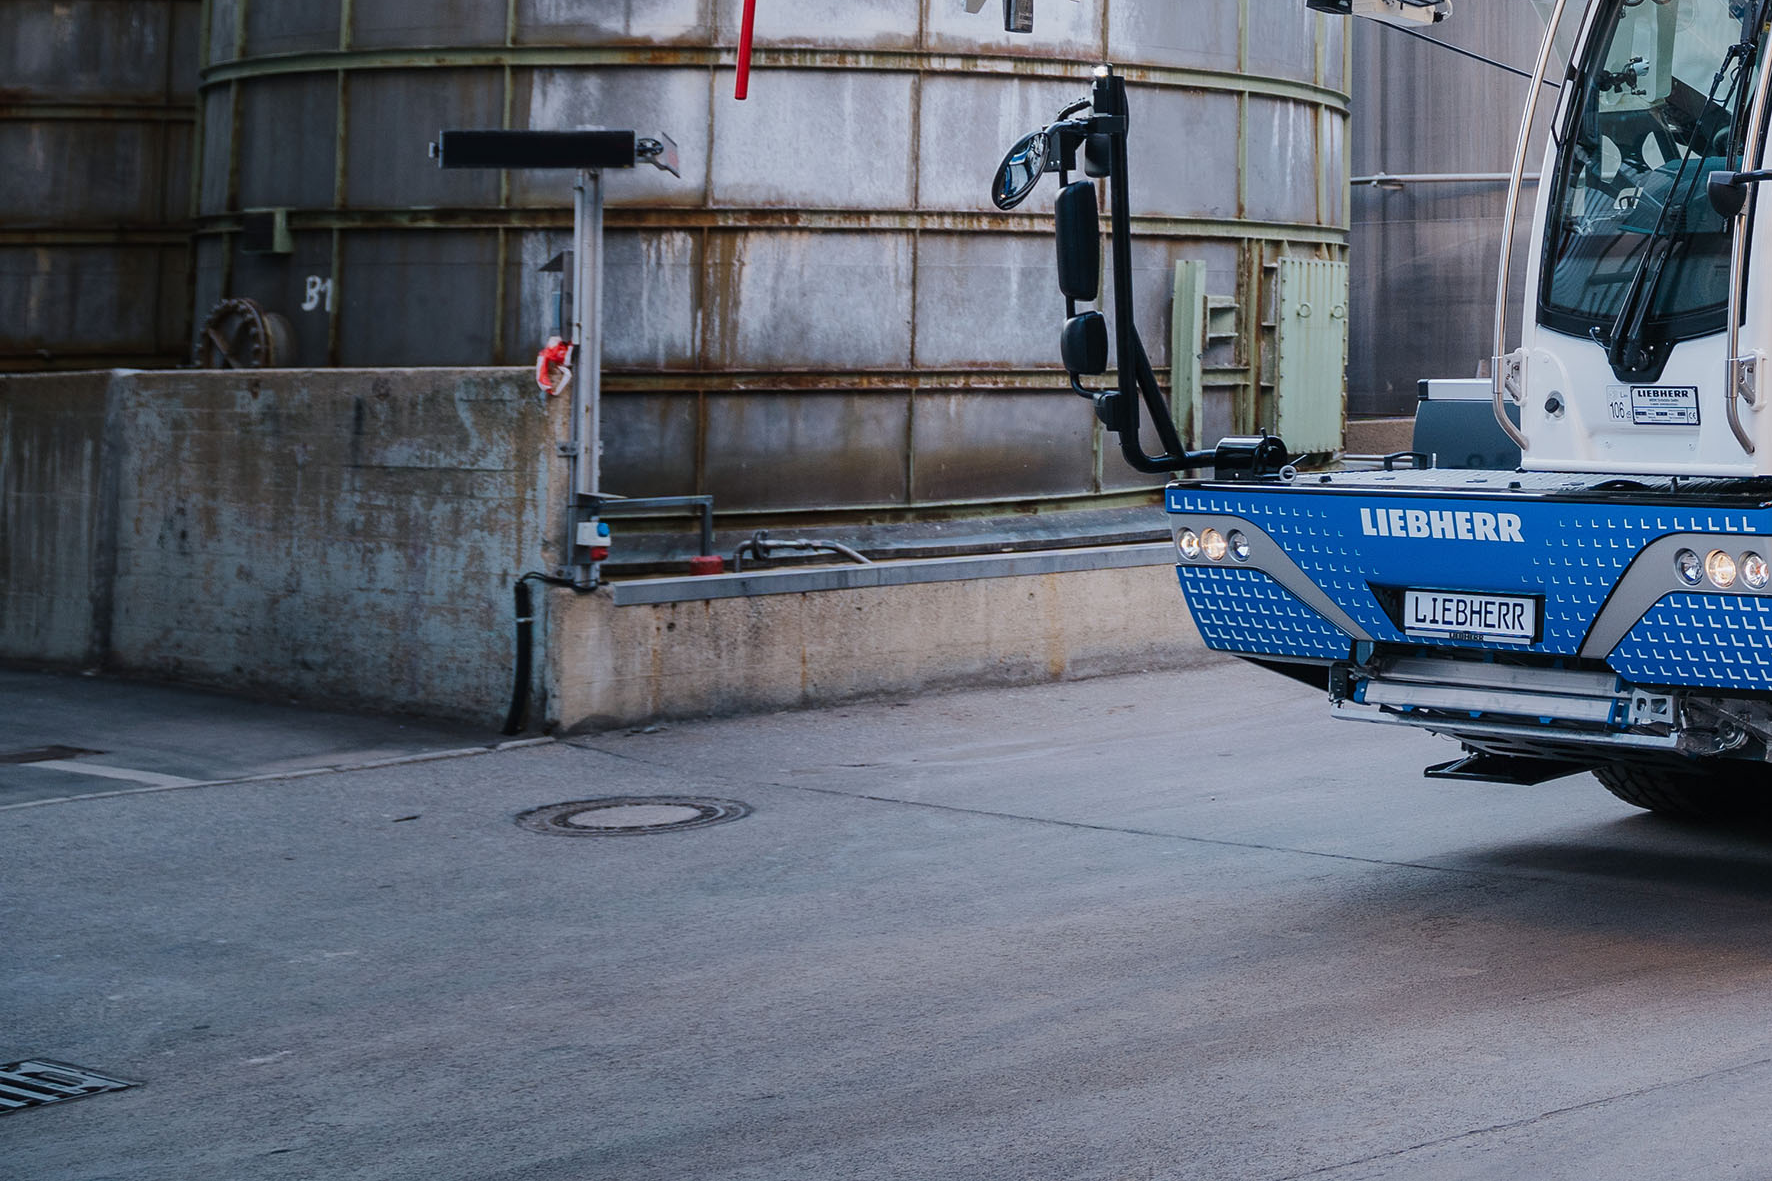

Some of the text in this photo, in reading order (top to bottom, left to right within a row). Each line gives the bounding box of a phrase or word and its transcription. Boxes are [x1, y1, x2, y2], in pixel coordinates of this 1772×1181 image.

[301, 275, 332, 312] B1
[1610, 402, 1624, 419] 106
[1637, 389, 1689, 398] LIEBHERR
[1360, 508, 1525, 543] LIEBHERR
[1414, 595, 1524, 631] LIEBHERR
